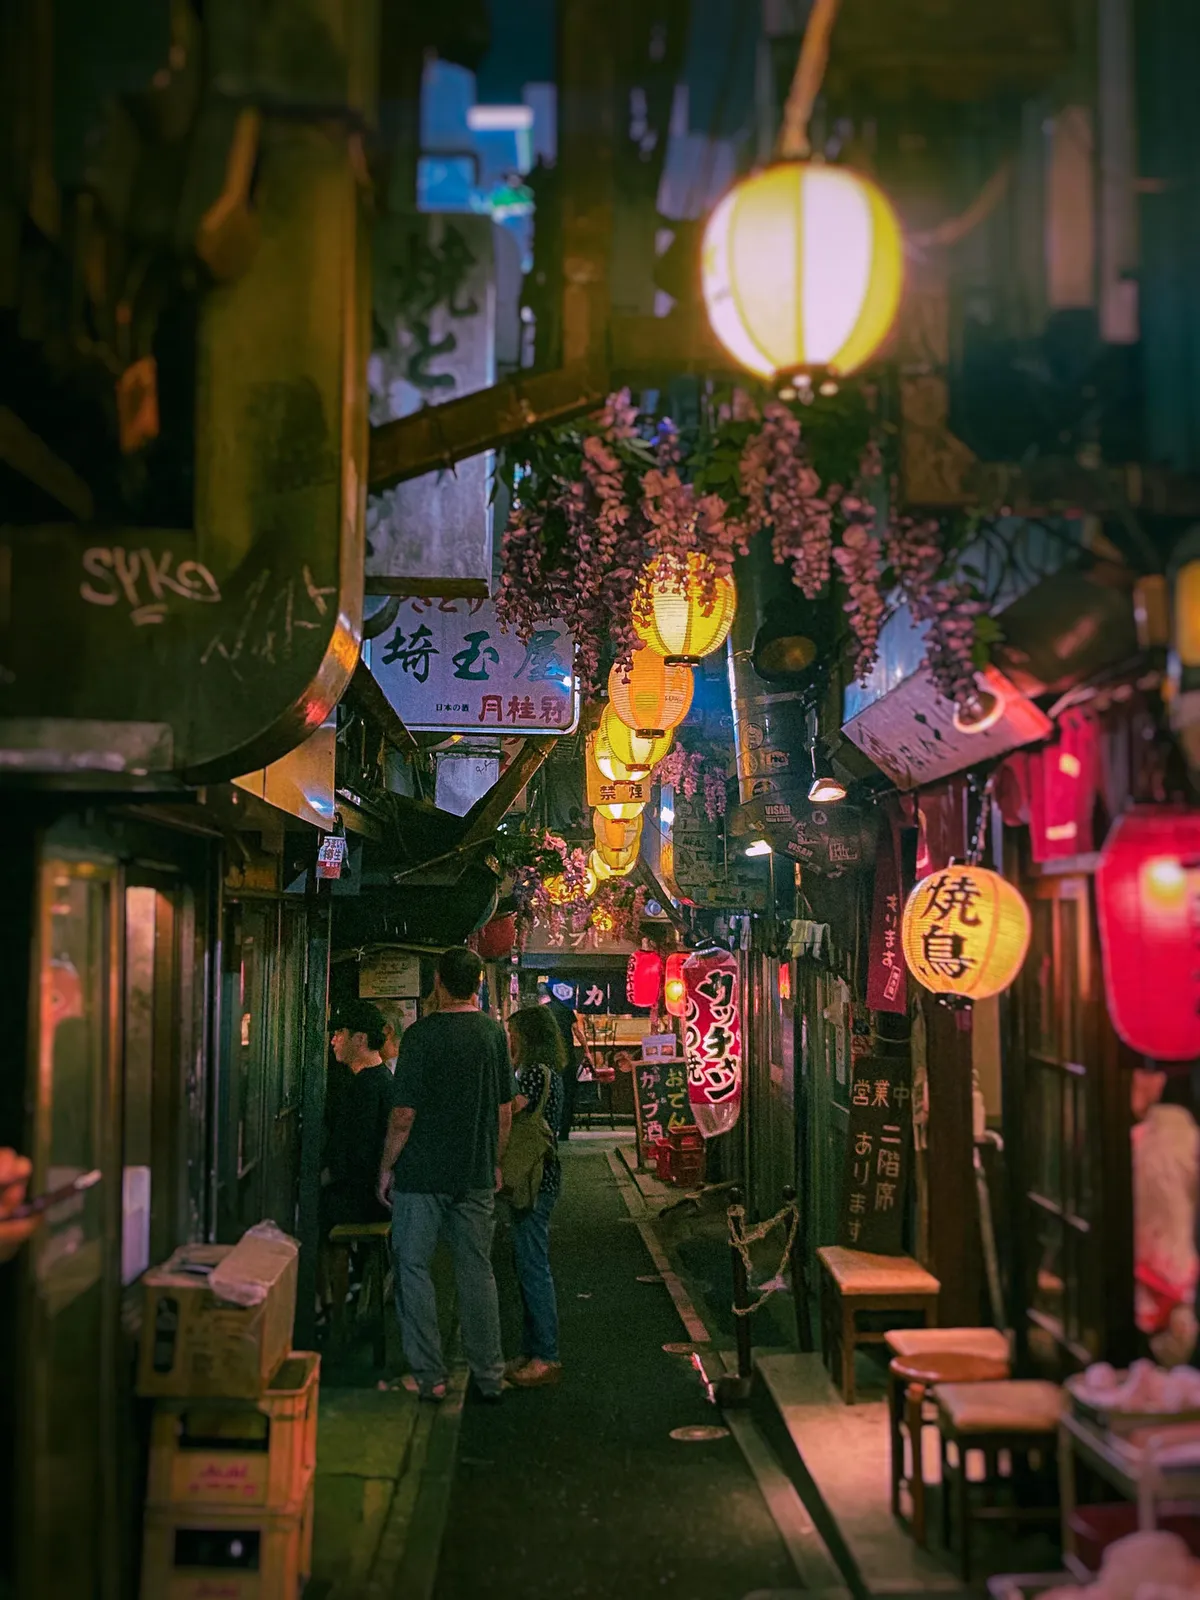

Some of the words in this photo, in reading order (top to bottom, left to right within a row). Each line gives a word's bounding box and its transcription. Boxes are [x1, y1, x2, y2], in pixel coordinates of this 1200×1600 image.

[381, 623, 567, 683] 埼玉屋
[435, 703, 470, 713] 日本の酒
[478, 694, 567, 723] 月桂冠
[599, 784, 643, 801] 禁煙
[919, 874, 983, 980] 焼鳥
[664, 1067, 687, 1131] おでん
[852, 1079, 911, 1108] 営業中
[848, 1131, 873, 1243] あります
[874, 1124, 902, 1212] 二階席
